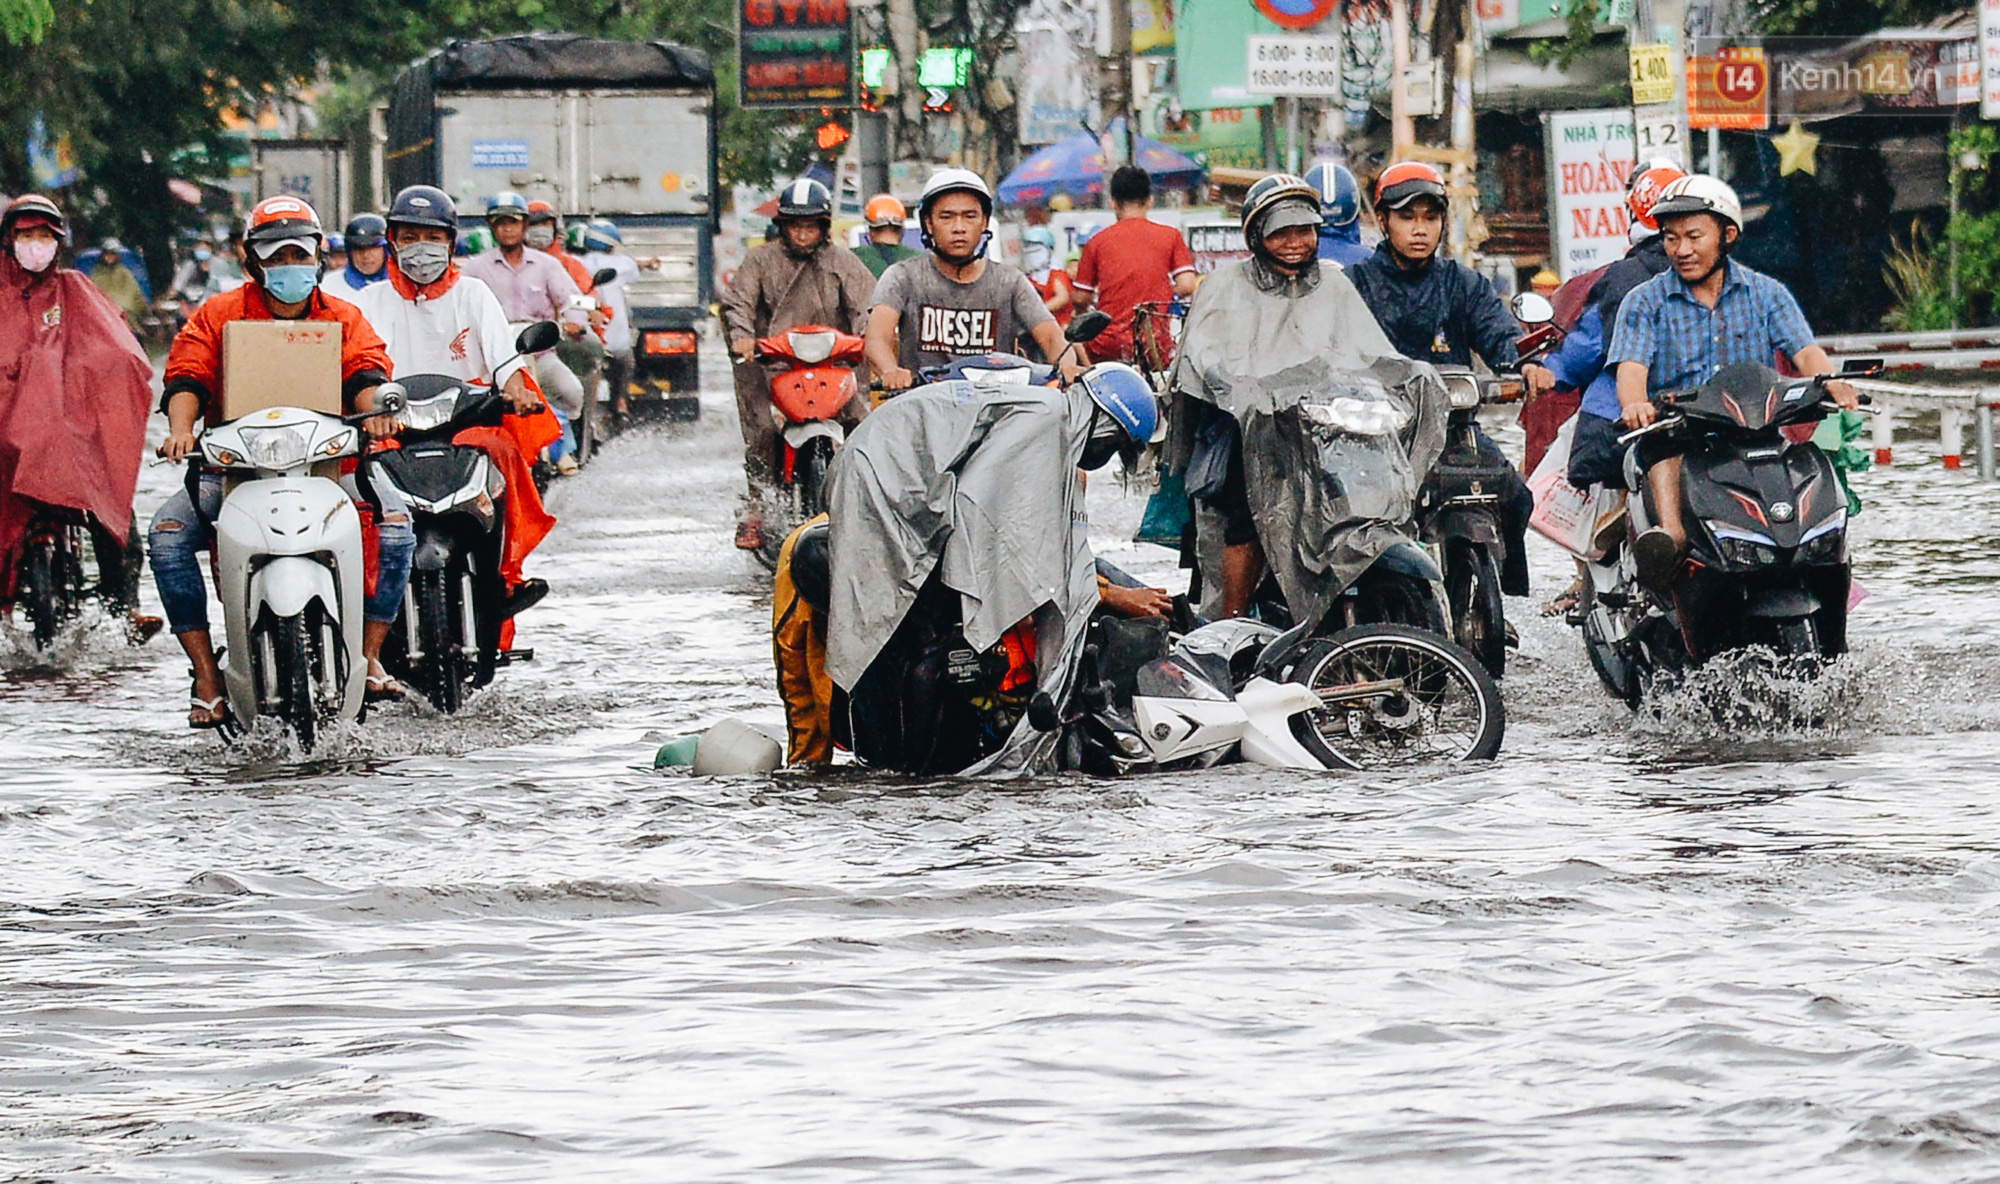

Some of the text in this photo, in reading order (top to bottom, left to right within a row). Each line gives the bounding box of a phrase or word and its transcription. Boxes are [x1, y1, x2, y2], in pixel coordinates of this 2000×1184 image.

[745, 0, 848, 26] GYM
[1304, 45, 1335, 62] 9:00
[1563, 121, 1598, 143] NHÀ
[921, 306, 995, 347] DIESEL
